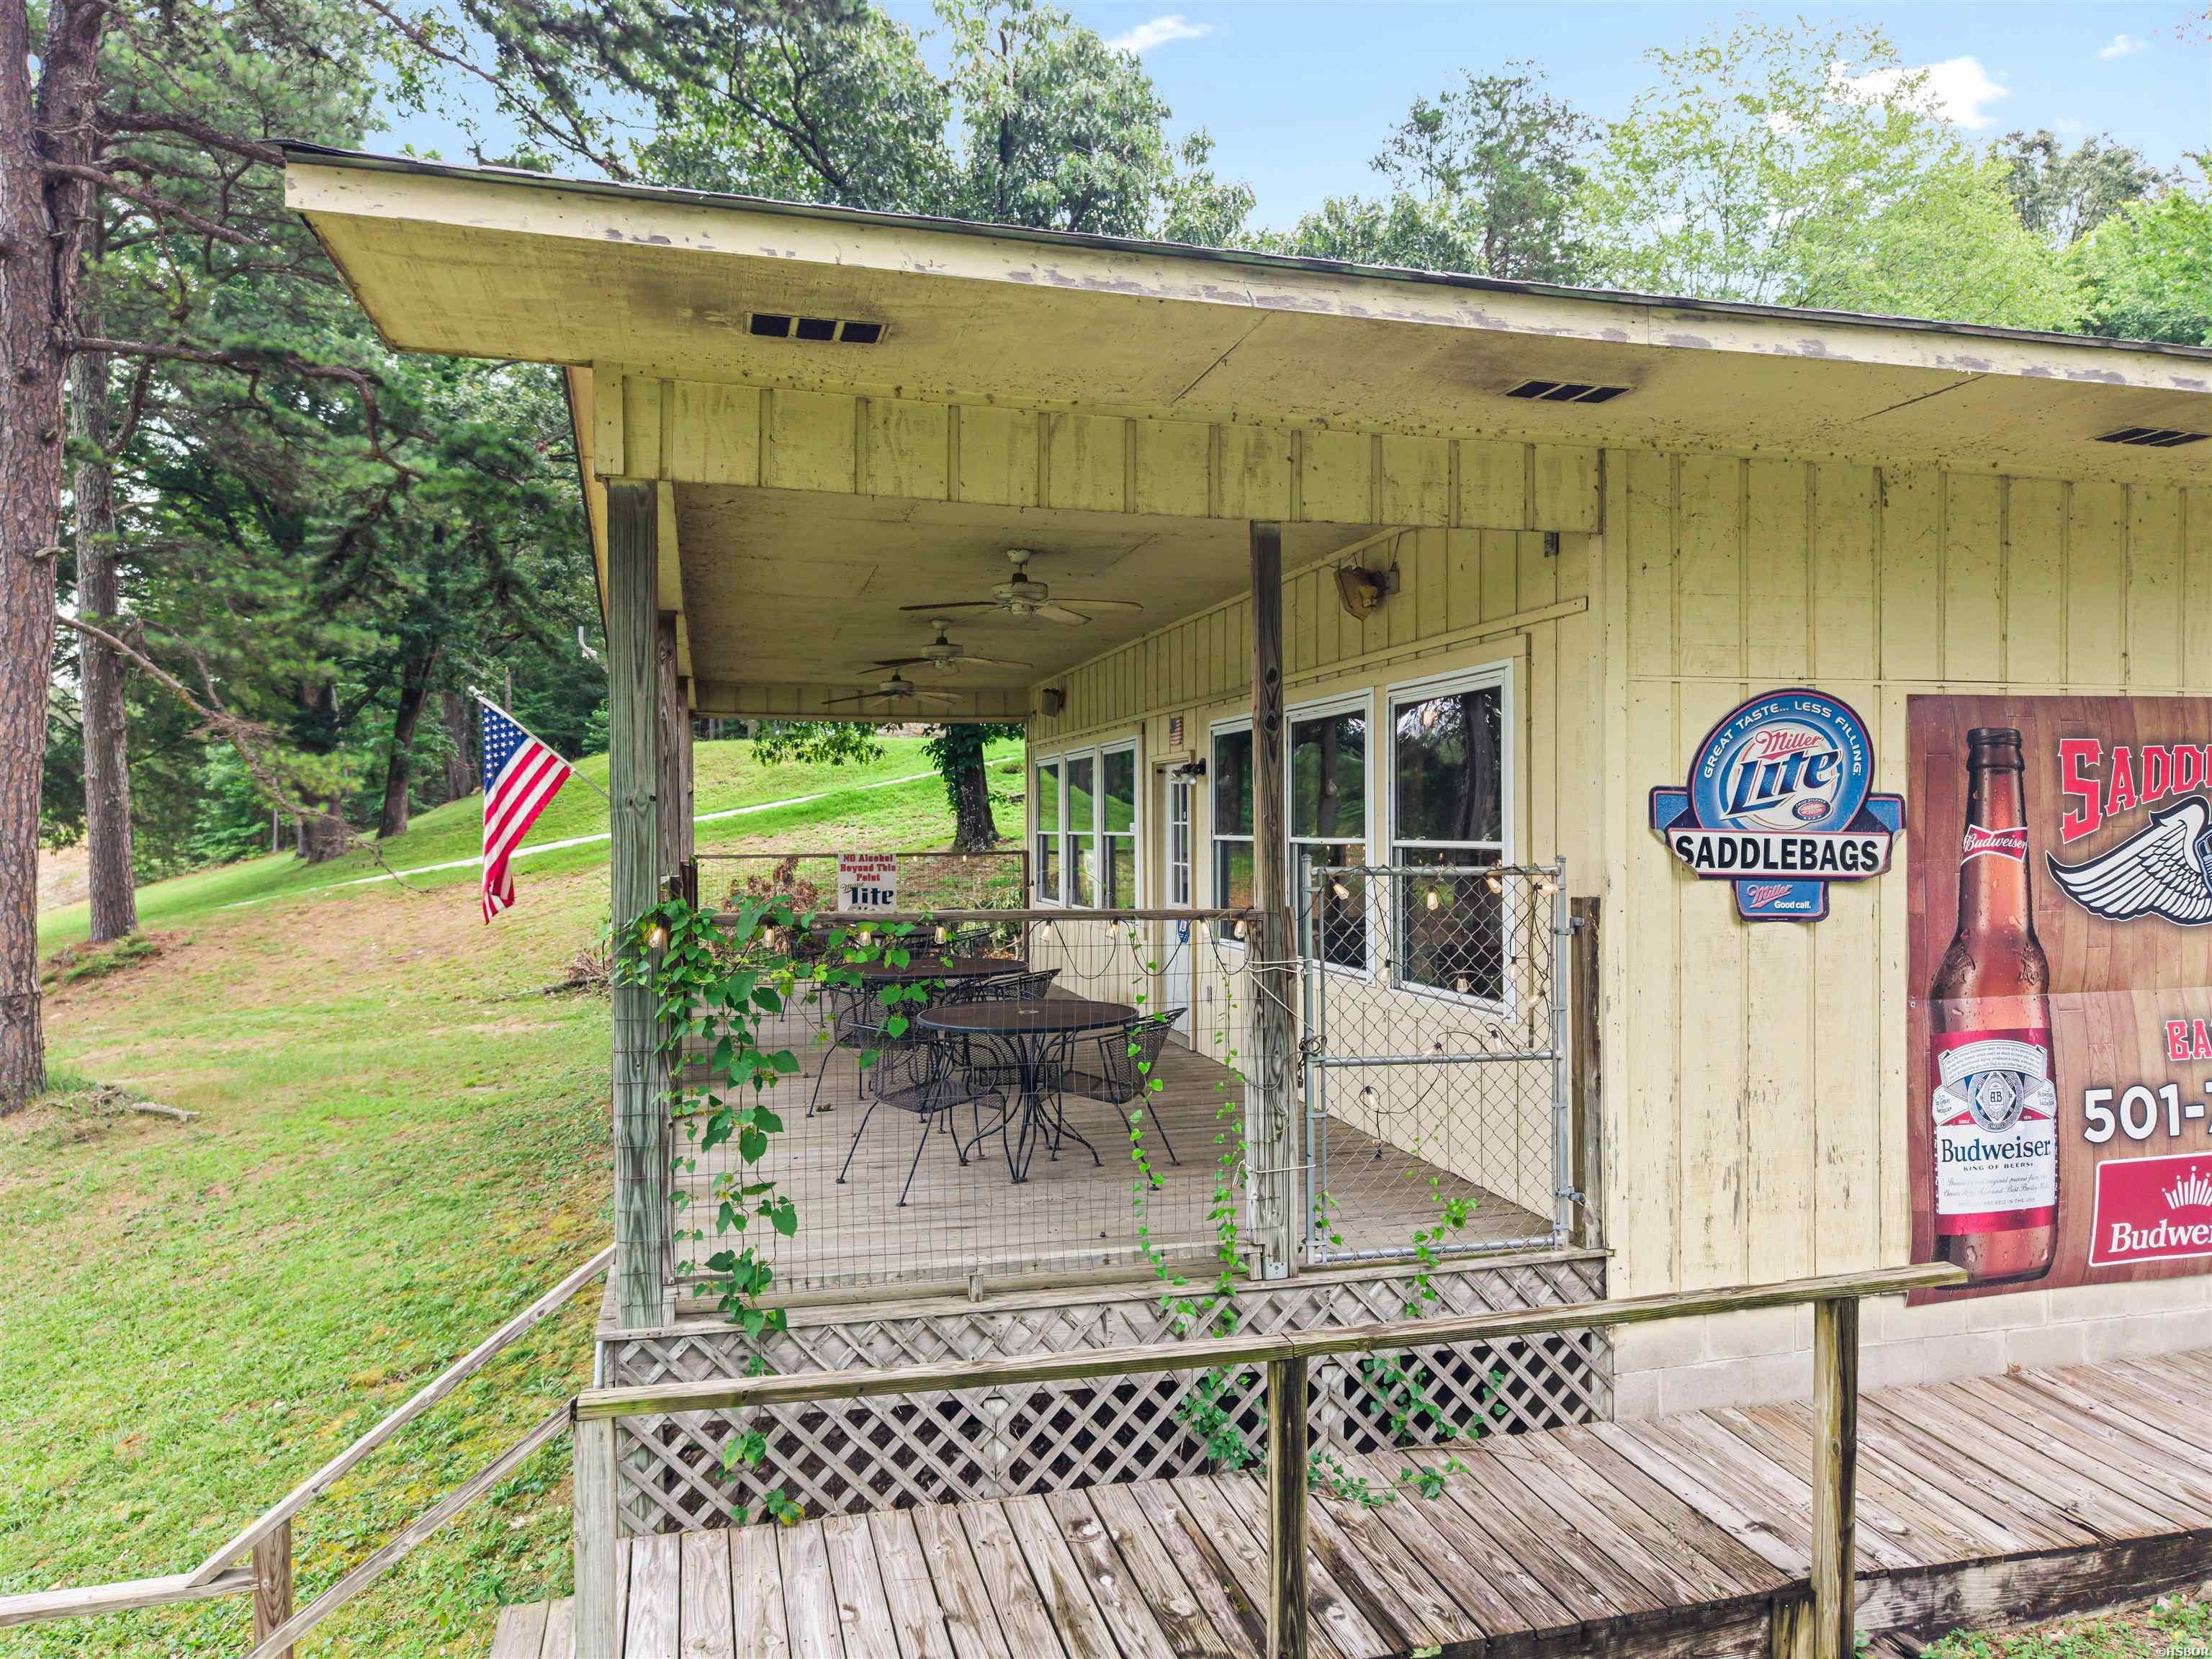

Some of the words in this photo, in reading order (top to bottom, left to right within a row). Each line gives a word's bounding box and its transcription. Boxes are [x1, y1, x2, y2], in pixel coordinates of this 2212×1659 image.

[1704, 729, 1733, 778] GREAT
[1735, 703, 1789, 729] TASTE...
[1794, 701, 1832, 718] LESS
[1755, 730, 1824, 755] Miller
[1719, 749, 1843, 820] Lite
[2058, 738, 2212, 844] SADD
[1675, 835, 1880, 871] SADDLEBAGS
[1963, 833, 2027, 853] Budweiser
[840, 864, 873, 873] Beyond
[1747, 884, 1793, 907] Miller
[2164, 1019, 2212, 1061] BA
[1941, 1136, 2051, 1163] Budweiser
